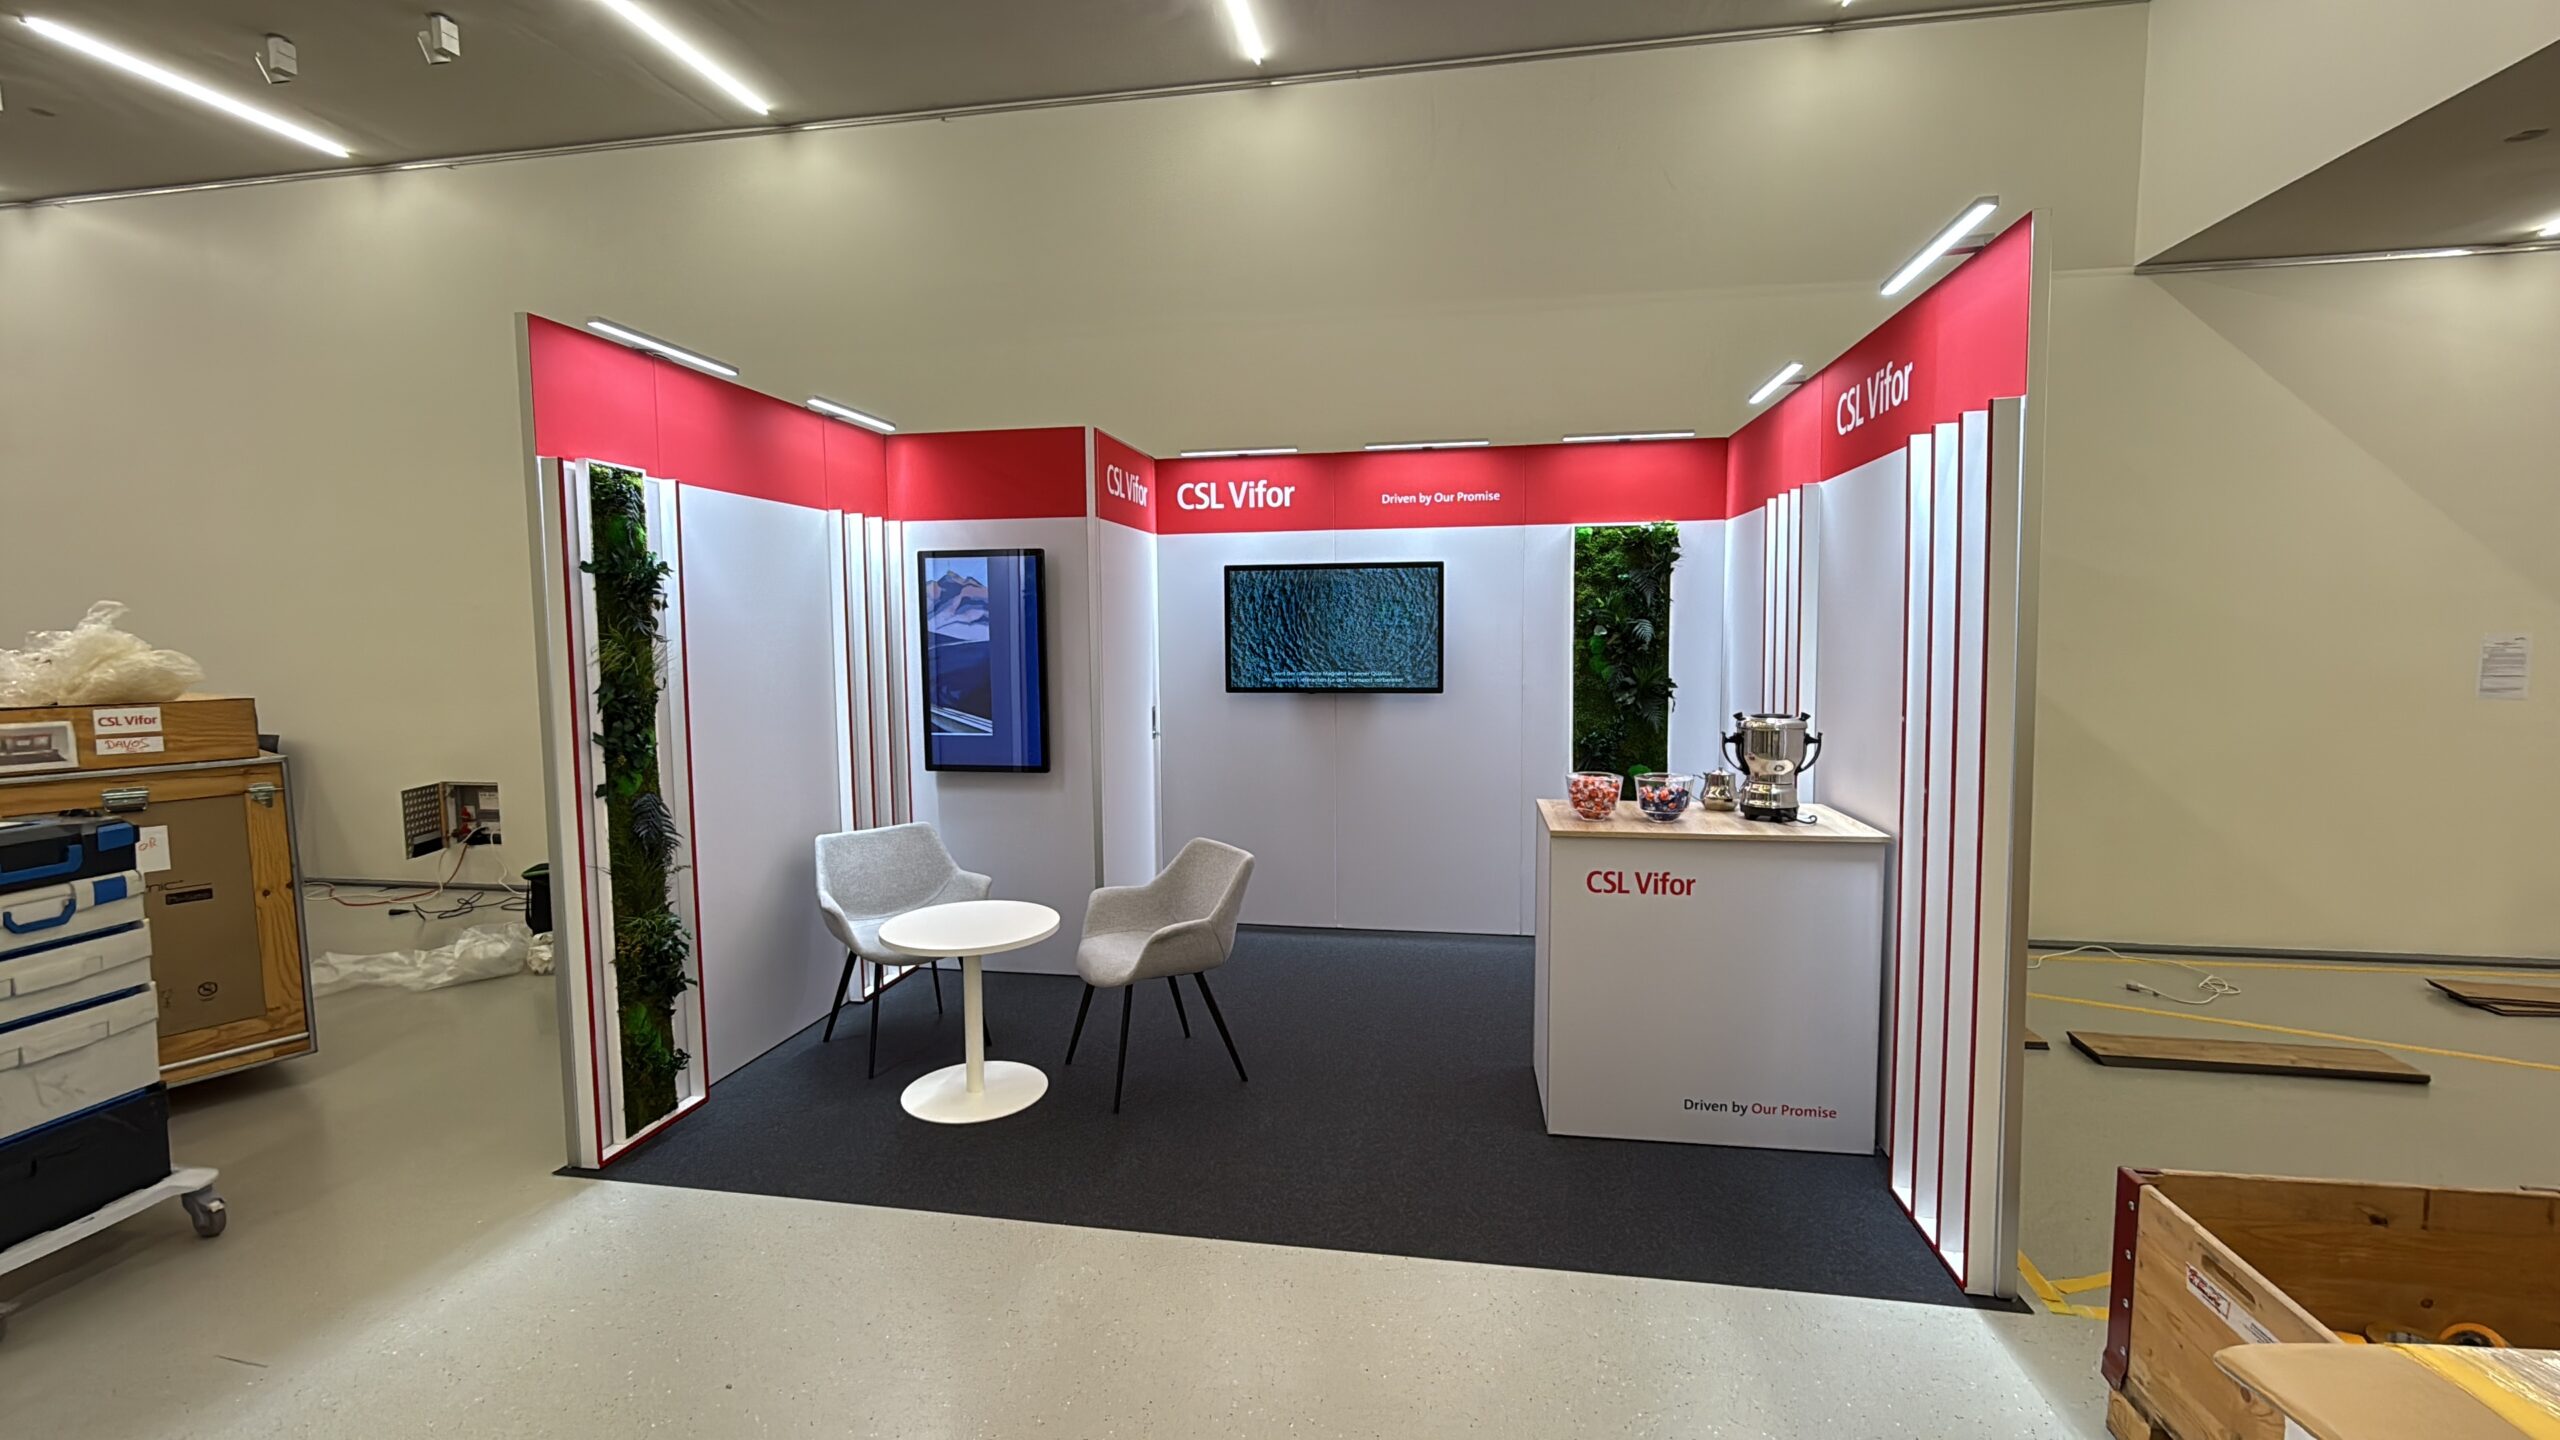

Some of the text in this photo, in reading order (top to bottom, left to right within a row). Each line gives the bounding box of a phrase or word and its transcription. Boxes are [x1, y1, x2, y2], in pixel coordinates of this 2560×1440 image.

[1837, 361, 1914, 436] CSL Vifor
[1106, 464, 1149, 508] CSL Vifor
[1176, 479, 1296, 510] CSL Vifor
[1381, 490, 1501, 506] Driven by Our Promise
[98, 715, 158, 727] CSL Vifor
[104, 738, 150, 751] DAVOS
[1586, 870, 1697, 896] CSL Vifor
[1683, 1099, 1837, 1119] Driven by Our Promise
